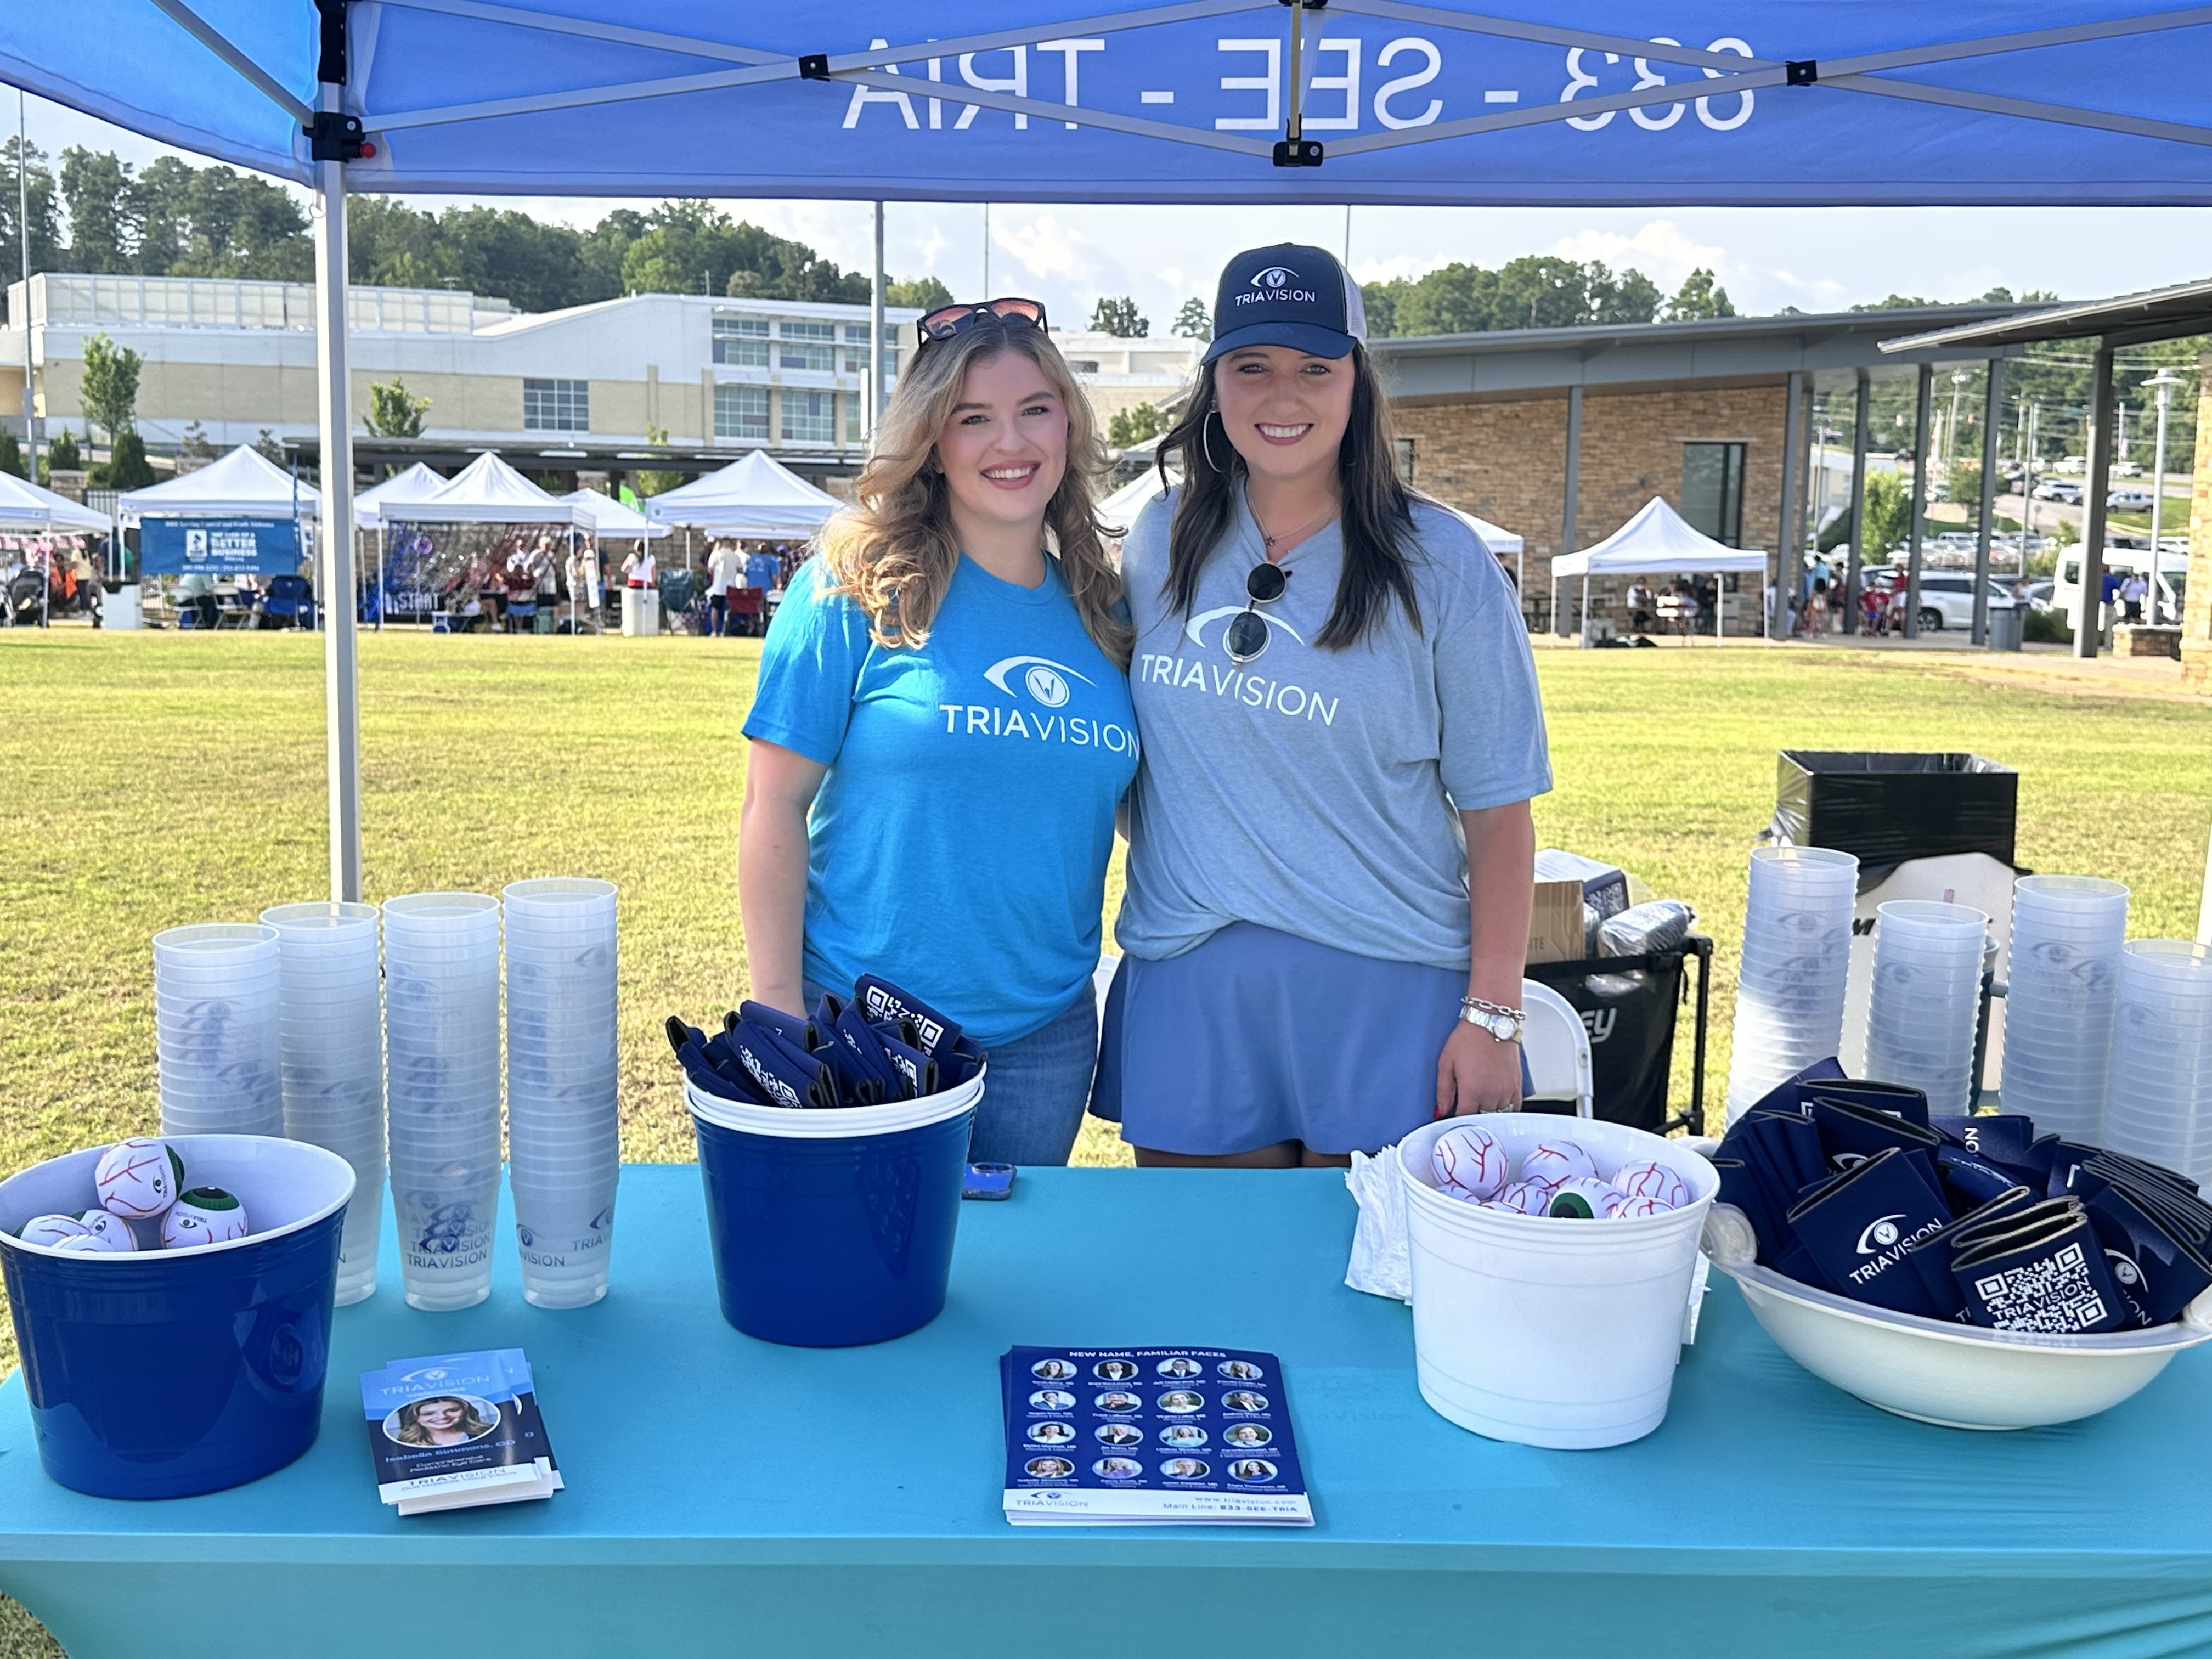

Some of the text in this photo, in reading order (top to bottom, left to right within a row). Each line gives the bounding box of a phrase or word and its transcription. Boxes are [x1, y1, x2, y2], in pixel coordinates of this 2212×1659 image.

[1235, 289, 1315, 307] TRIAVISION
[1141, 654, 1339, 726] TRIAVISION
[939, 704, 1139, 761] TRIAVISION
[407, 1249, 487, 1268] TRIAVISION
[1992, 1276, 2090, 1320] TRIAVISION
[379, 1375, 490, 1396] TRIAVISION
[1016, 1499, 1088, 1508] TRIAVISION
